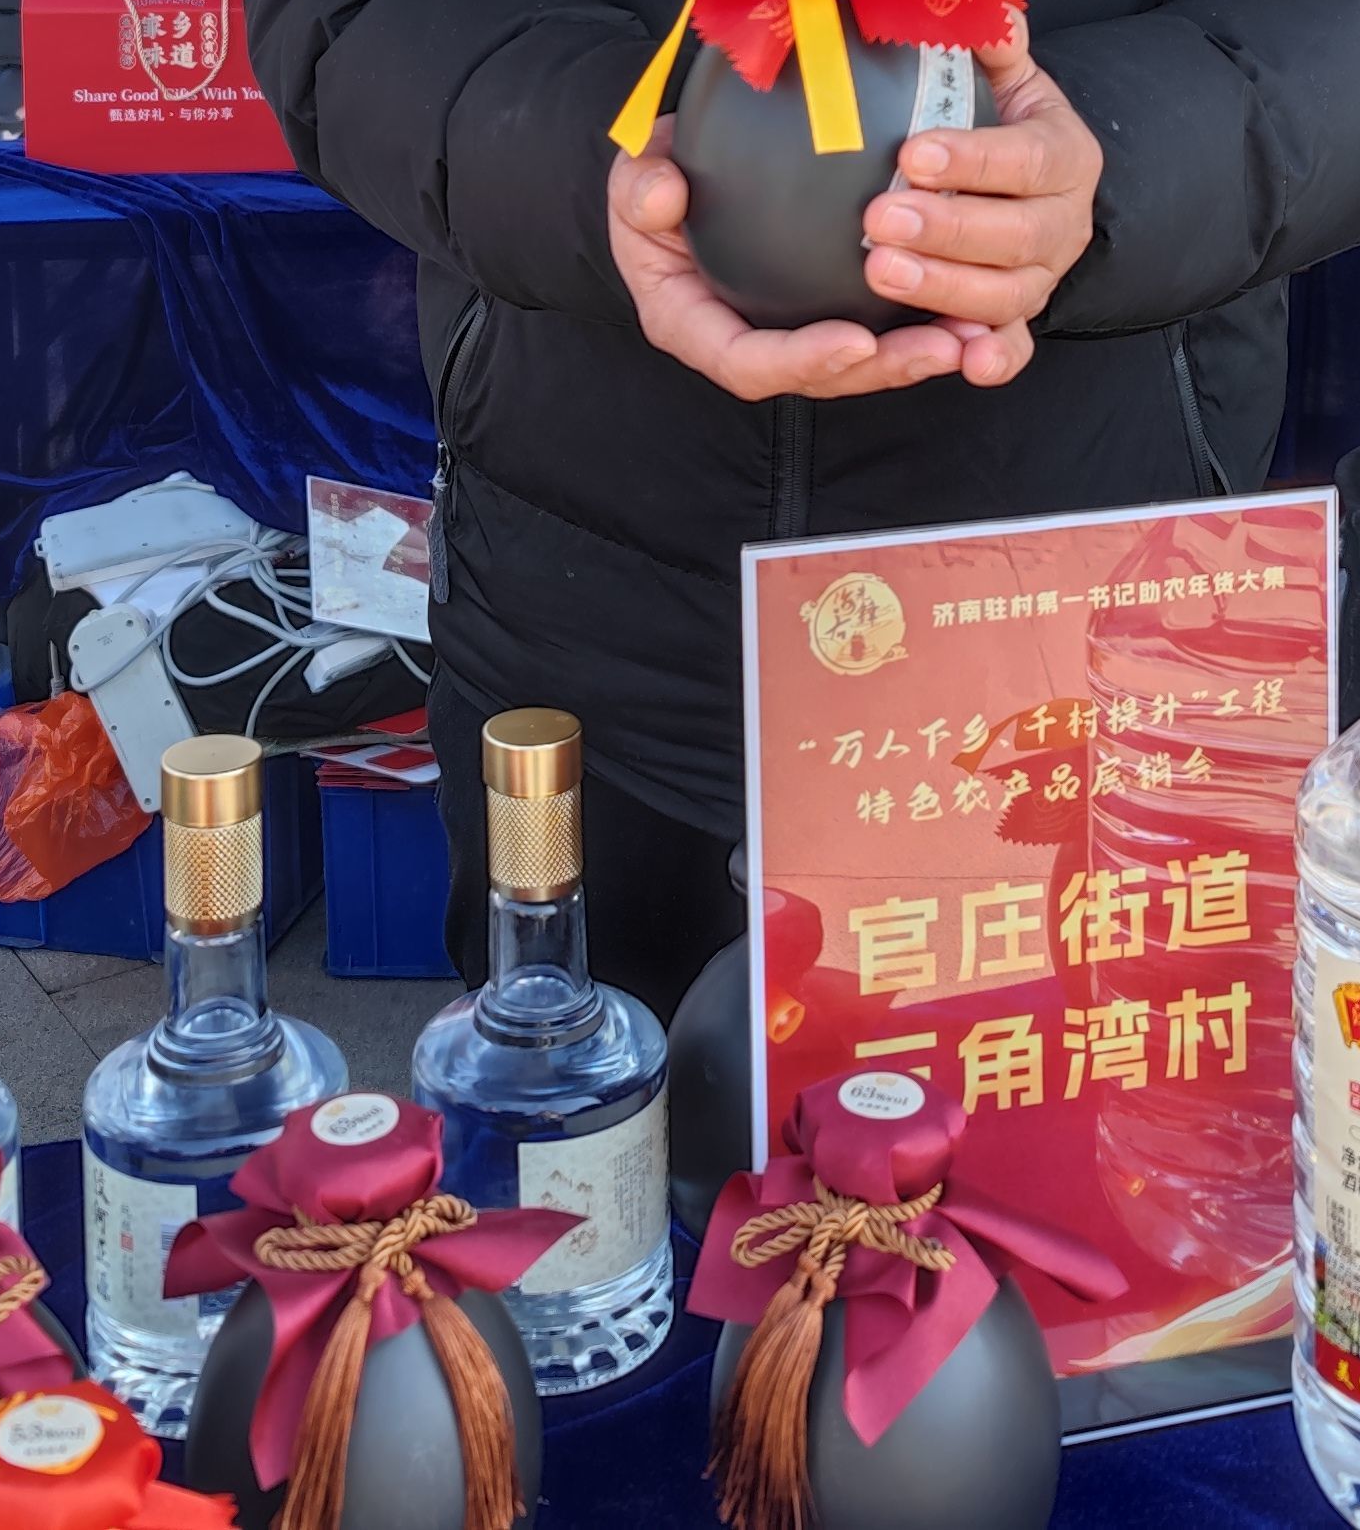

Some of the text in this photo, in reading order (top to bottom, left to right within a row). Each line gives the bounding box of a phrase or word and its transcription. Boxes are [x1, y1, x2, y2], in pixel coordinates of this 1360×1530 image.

[141, 11, 192, 40] 家乡
[141, 41, 199, 69] 味道
[74, 88, 117, 103] Share
[121, 87, 159, 103] Good
[203, 87, 238, 101] With
[932, 565, 1287, 628] 济南驻村第一书记助农年货大集
[854, 745, 1218, 826] 特色农产品展销会
[847, 849, 1252, 997] 官庄街道
